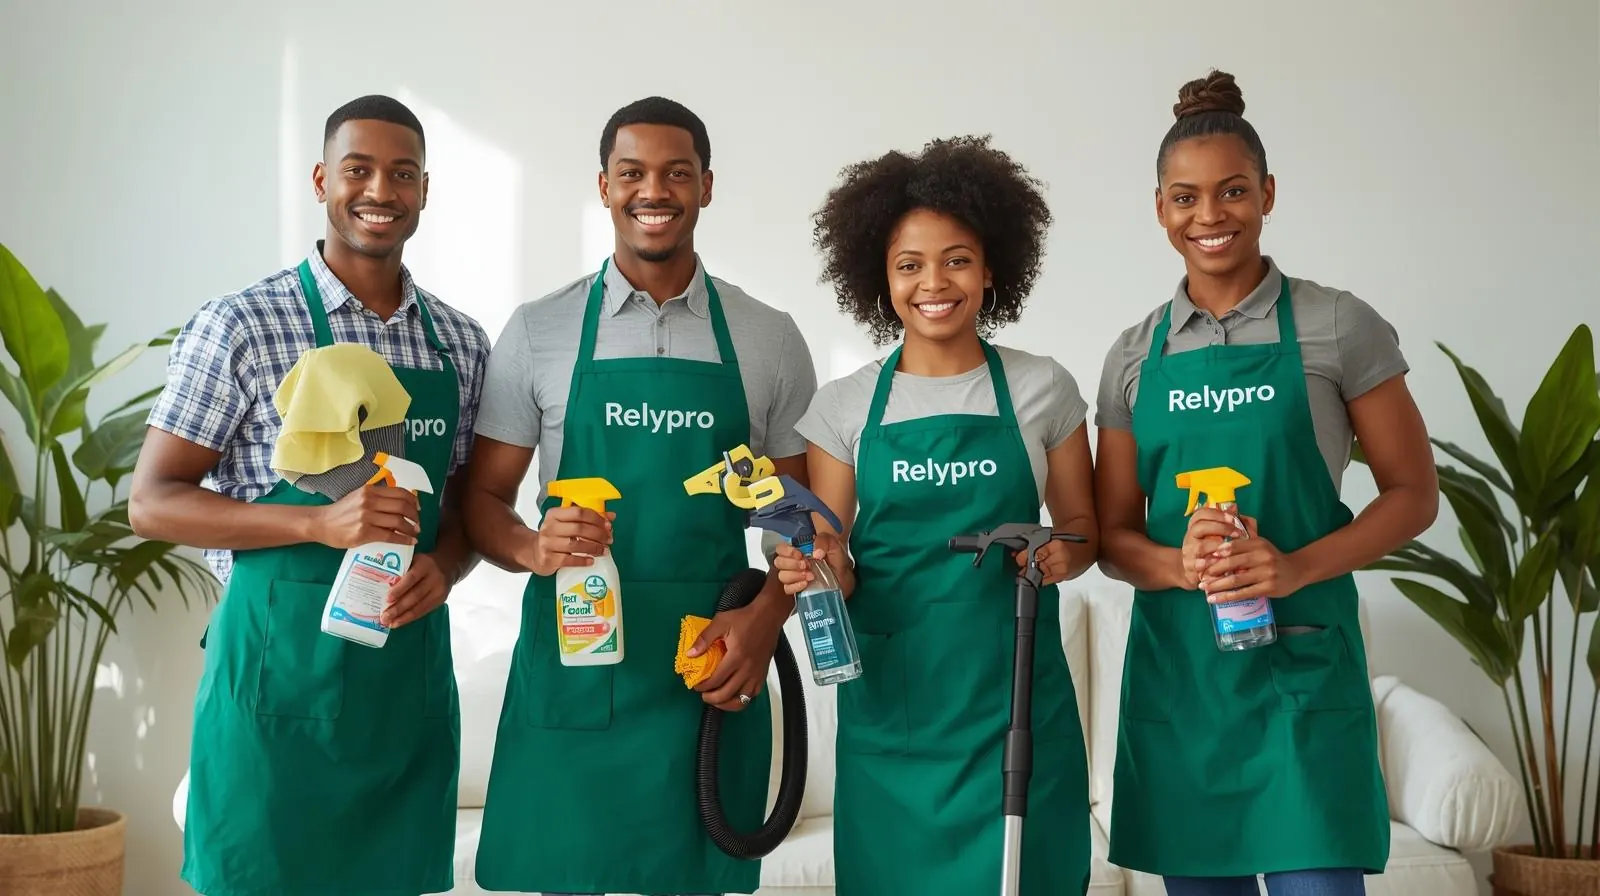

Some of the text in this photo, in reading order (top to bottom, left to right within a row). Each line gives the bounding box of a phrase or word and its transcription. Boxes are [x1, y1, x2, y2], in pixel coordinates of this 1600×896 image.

[1168, 384, 1275, 413] Relypro
[605, 402, 715, 434] Relypro
[892, 457, 997, 487] Relypro
